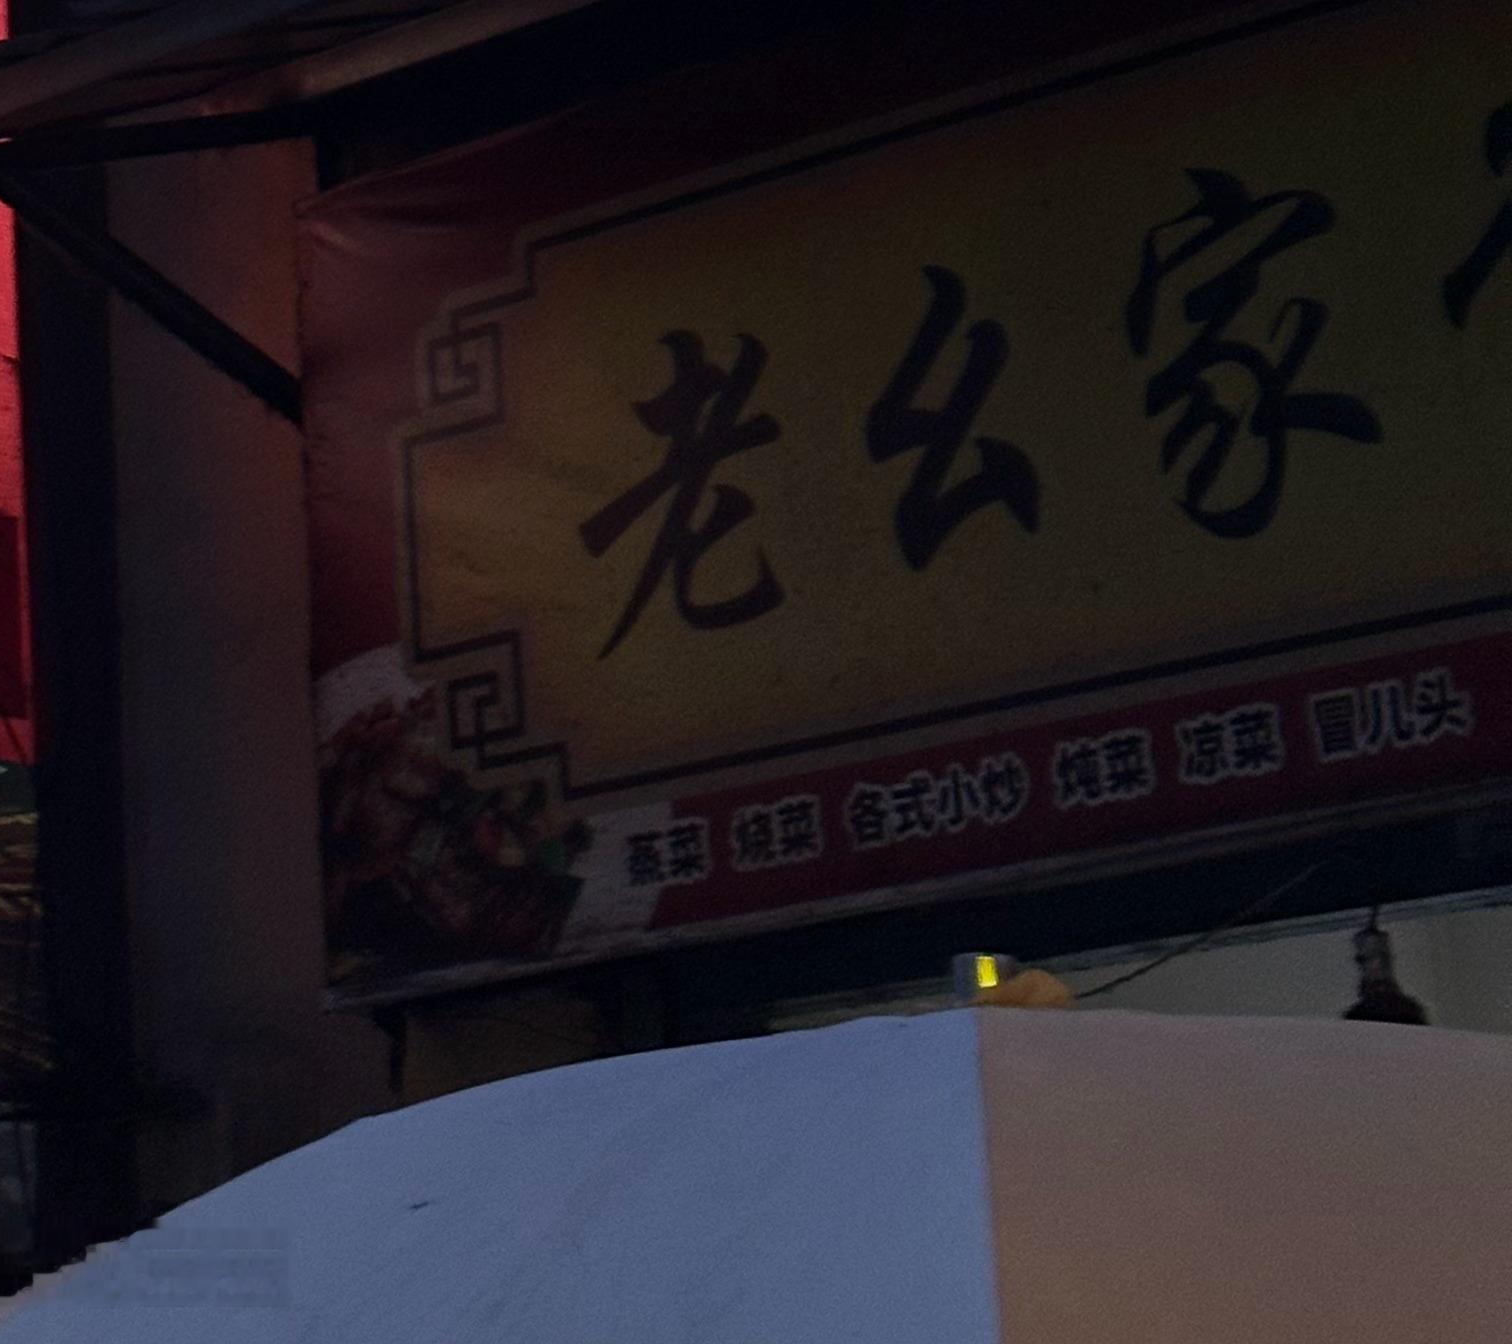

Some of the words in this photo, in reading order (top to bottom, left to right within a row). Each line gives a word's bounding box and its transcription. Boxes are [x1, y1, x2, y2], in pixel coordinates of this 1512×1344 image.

[579, 102, 1512, 660] 老幺家
[845, 750, 1029, 850] 各式小炒
[1177, 703, 1284, 784] 凉菜
